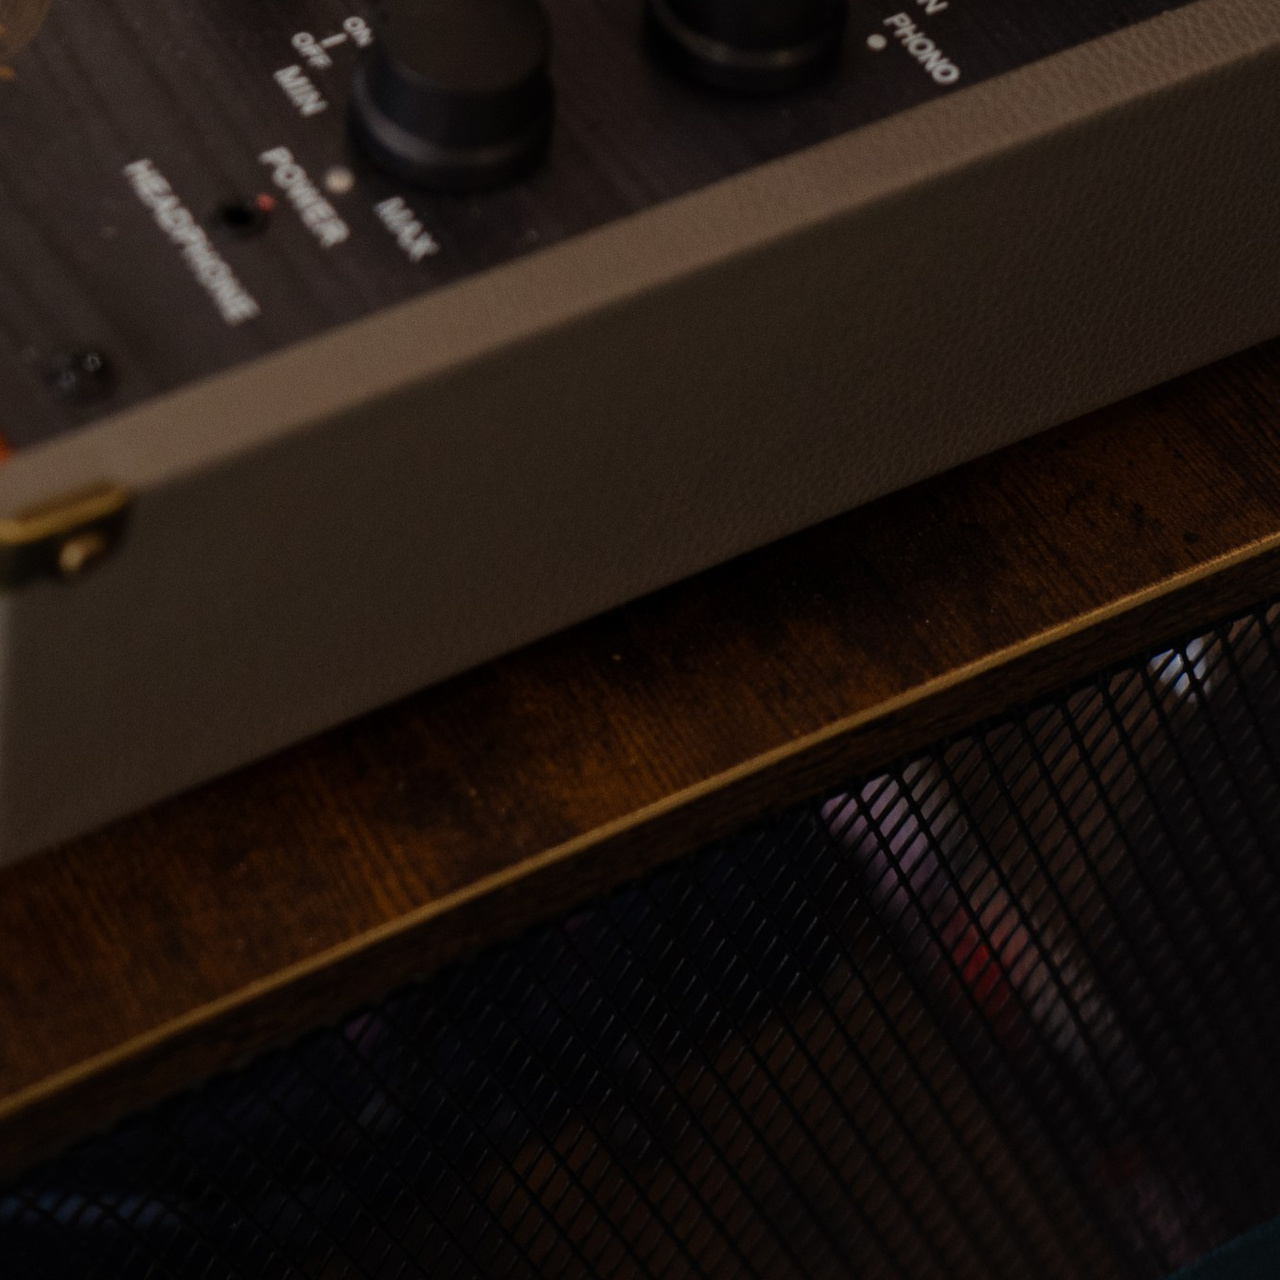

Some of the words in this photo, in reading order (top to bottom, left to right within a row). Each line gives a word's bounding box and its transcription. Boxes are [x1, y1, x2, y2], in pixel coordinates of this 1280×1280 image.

[291, 31, 333, 69] OFF
[343, 15, 374, 48] ON
[882, 11, 961, 85] PHONO
[272, 63, 329, 118] MIN
[257, 145, 351, 248] POWER
[373, 195, 441, 263] MAX
[122, 157, 261, 327] HEADPHONE
